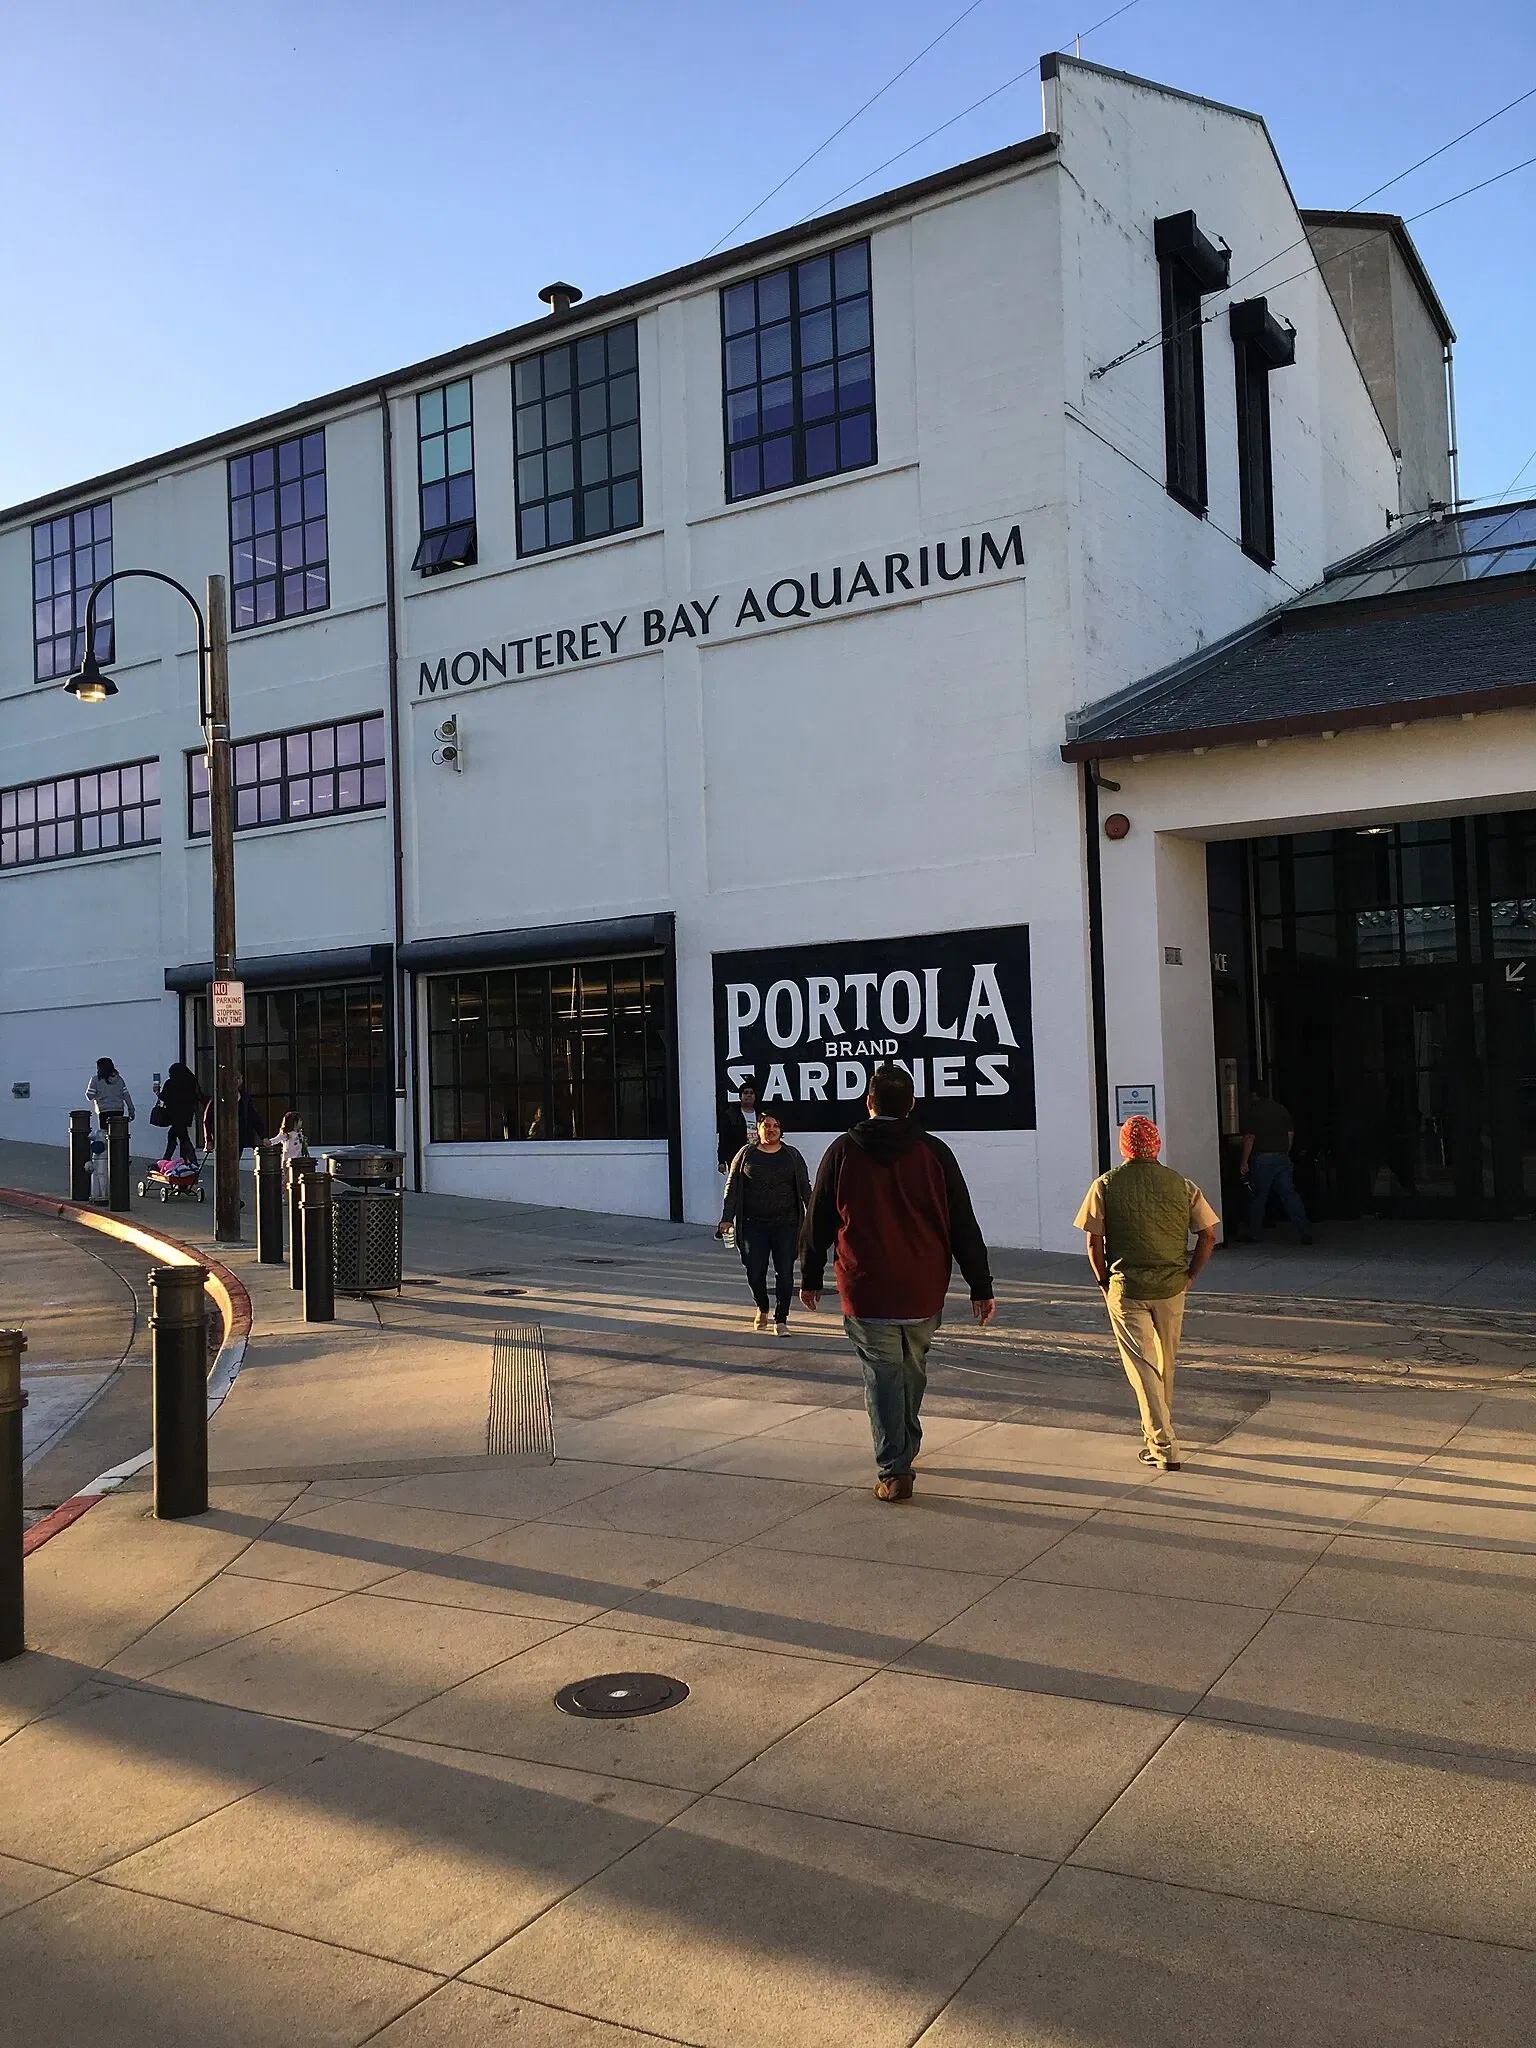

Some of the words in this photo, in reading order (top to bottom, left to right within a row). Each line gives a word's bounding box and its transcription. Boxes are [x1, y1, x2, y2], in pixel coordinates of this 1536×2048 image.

[419, 614, 627, 696] MONTEREY
[644, 595, 720, 647] BAY
[735, 525, 1026, 628] AQUARIUM
[215, 984, 226, 994] NO
[725, 962, 1020, 1061] PORTOLA
[825, 1038, 899, 1058] BRAND
